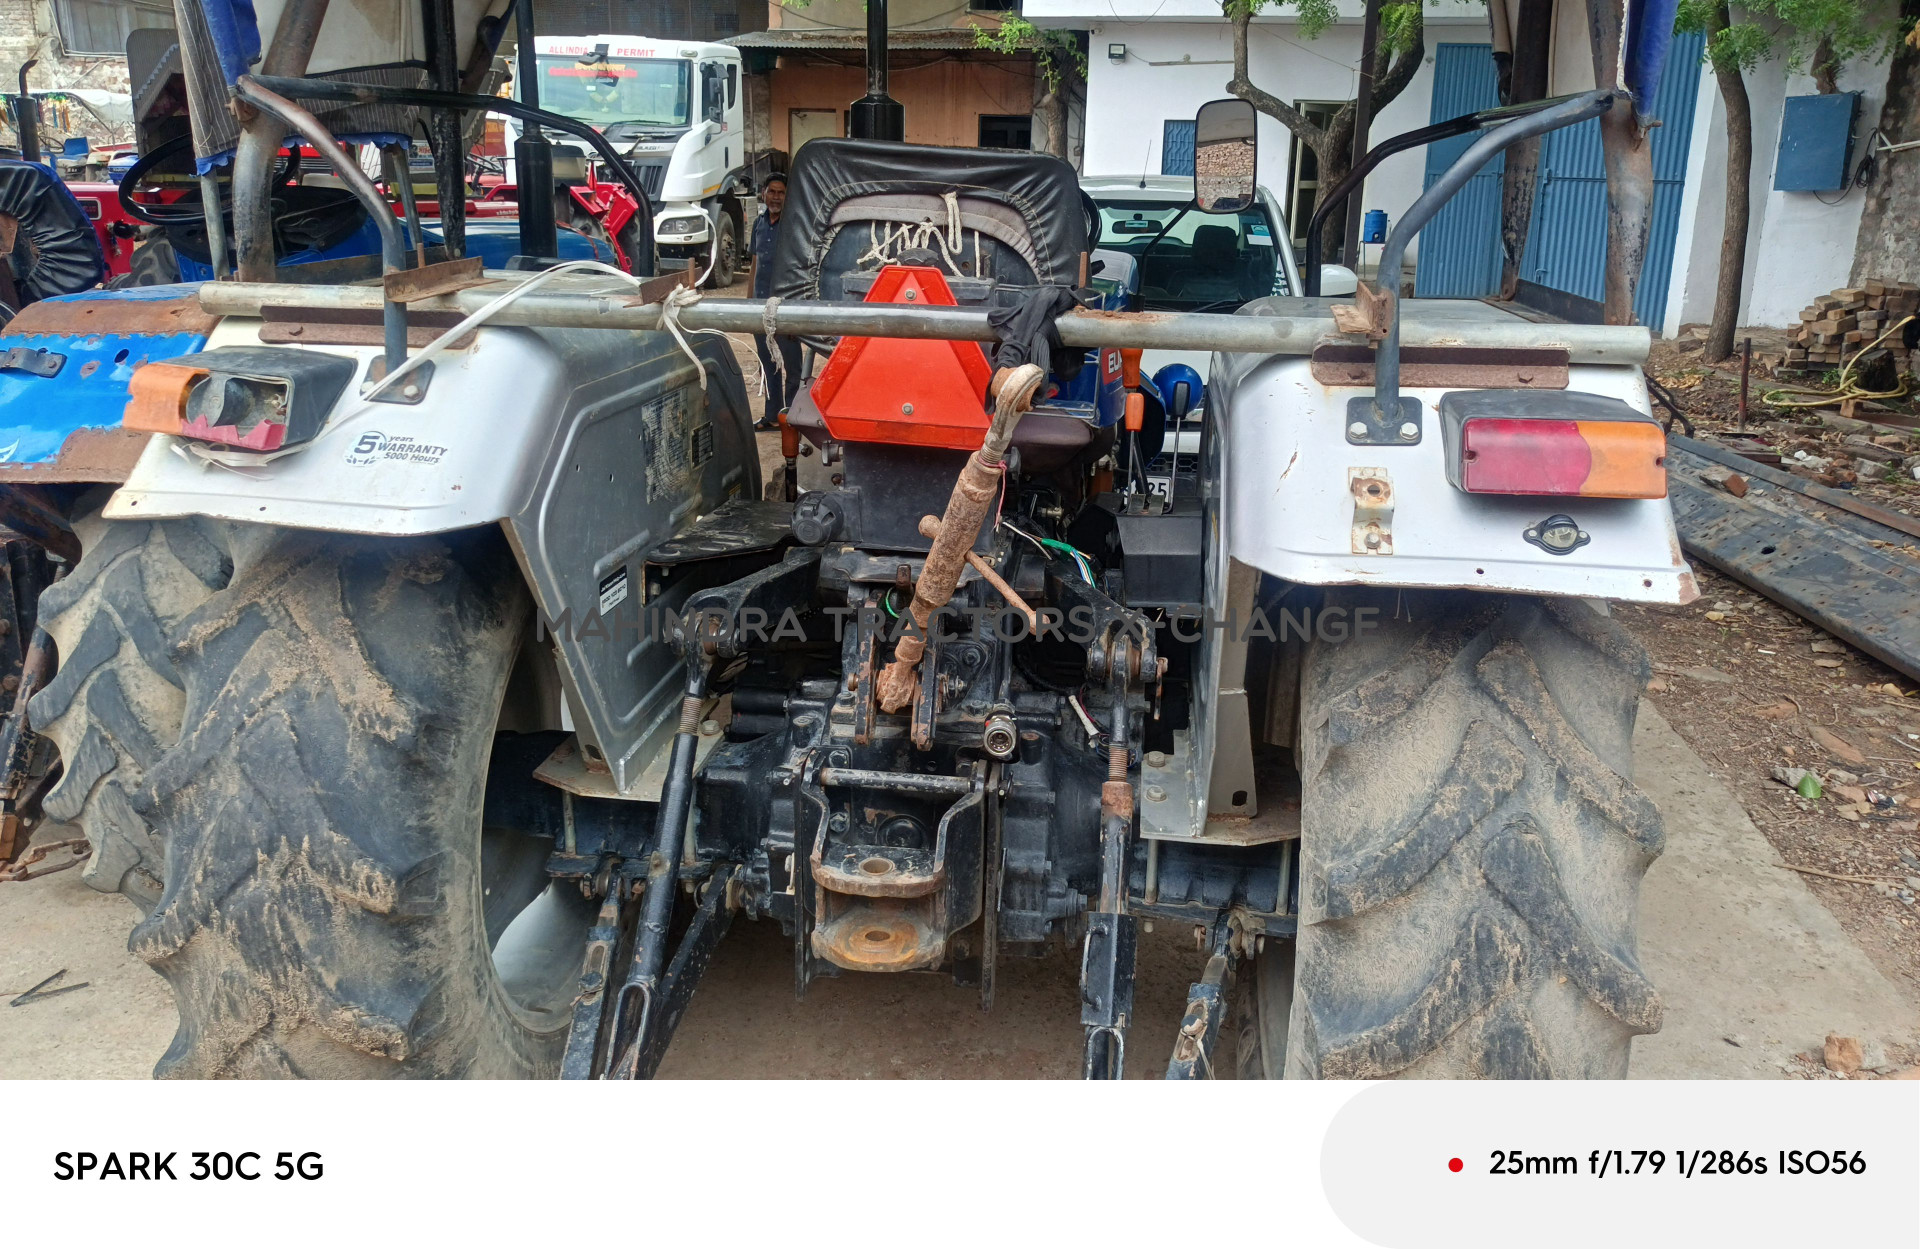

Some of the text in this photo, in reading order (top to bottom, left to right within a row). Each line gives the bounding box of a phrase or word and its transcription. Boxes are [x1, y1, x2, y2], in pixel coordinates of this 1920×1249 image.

[549, 45, 656, 57] ALL INDIA PERMIT
[353, 434, 380, 454] 5
[388, 435, 414, 443] years
[378, 442, 448, 457] WARRANTY
[384, 451, 440, 464] 5000 Hours
